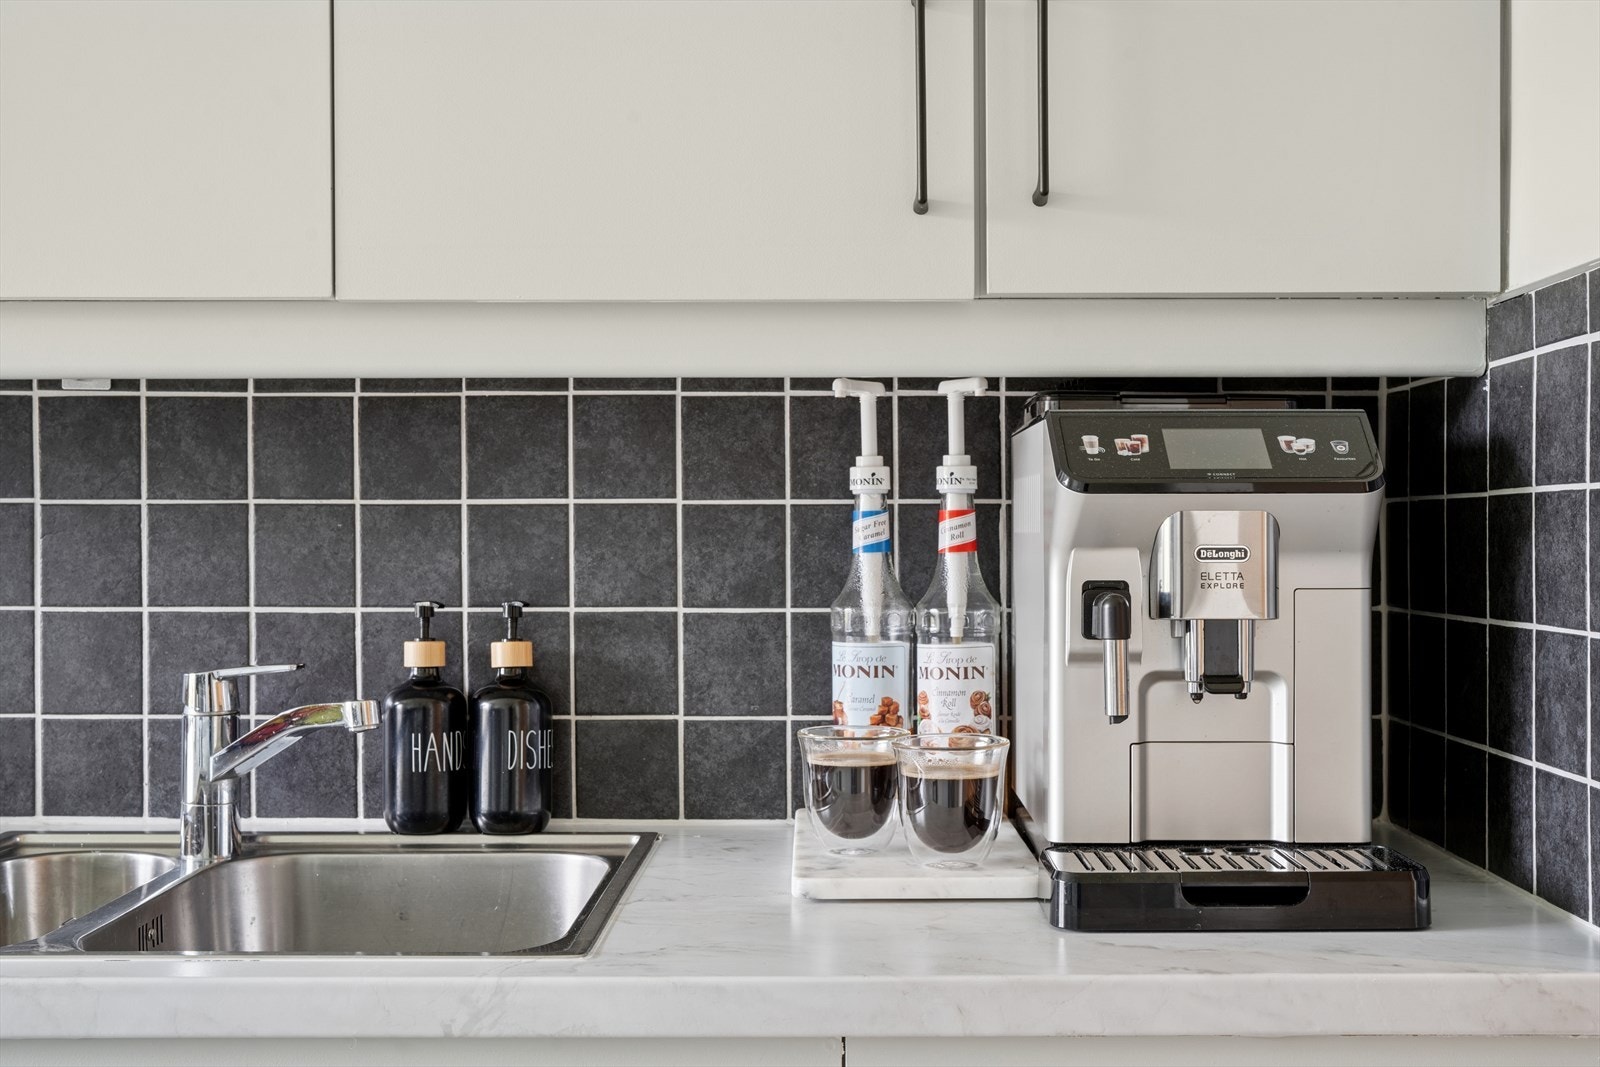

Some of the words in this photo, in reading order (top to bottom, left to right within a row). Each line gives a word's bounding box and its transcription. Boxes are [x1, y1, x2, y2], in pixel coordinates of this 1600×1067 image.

[873, 520, 887, 528] Free
[940, 521, 972, 535] Cinamon
[861, 529, 885, 540] aramel
[950, 531, 964, 541] Roll
[1200, 572, 1245, 581] ELETTA
[875, 655, 887, 663] de
[965, 656, 978, 664] de
[833, 664, 895, 679] MONIN
[919, 665, 986, 681] MONIN
[849, 692, 876, 704] aramel
[411, 730, 467, 773] HAND
[507, 729, 554, 771] DISHE
